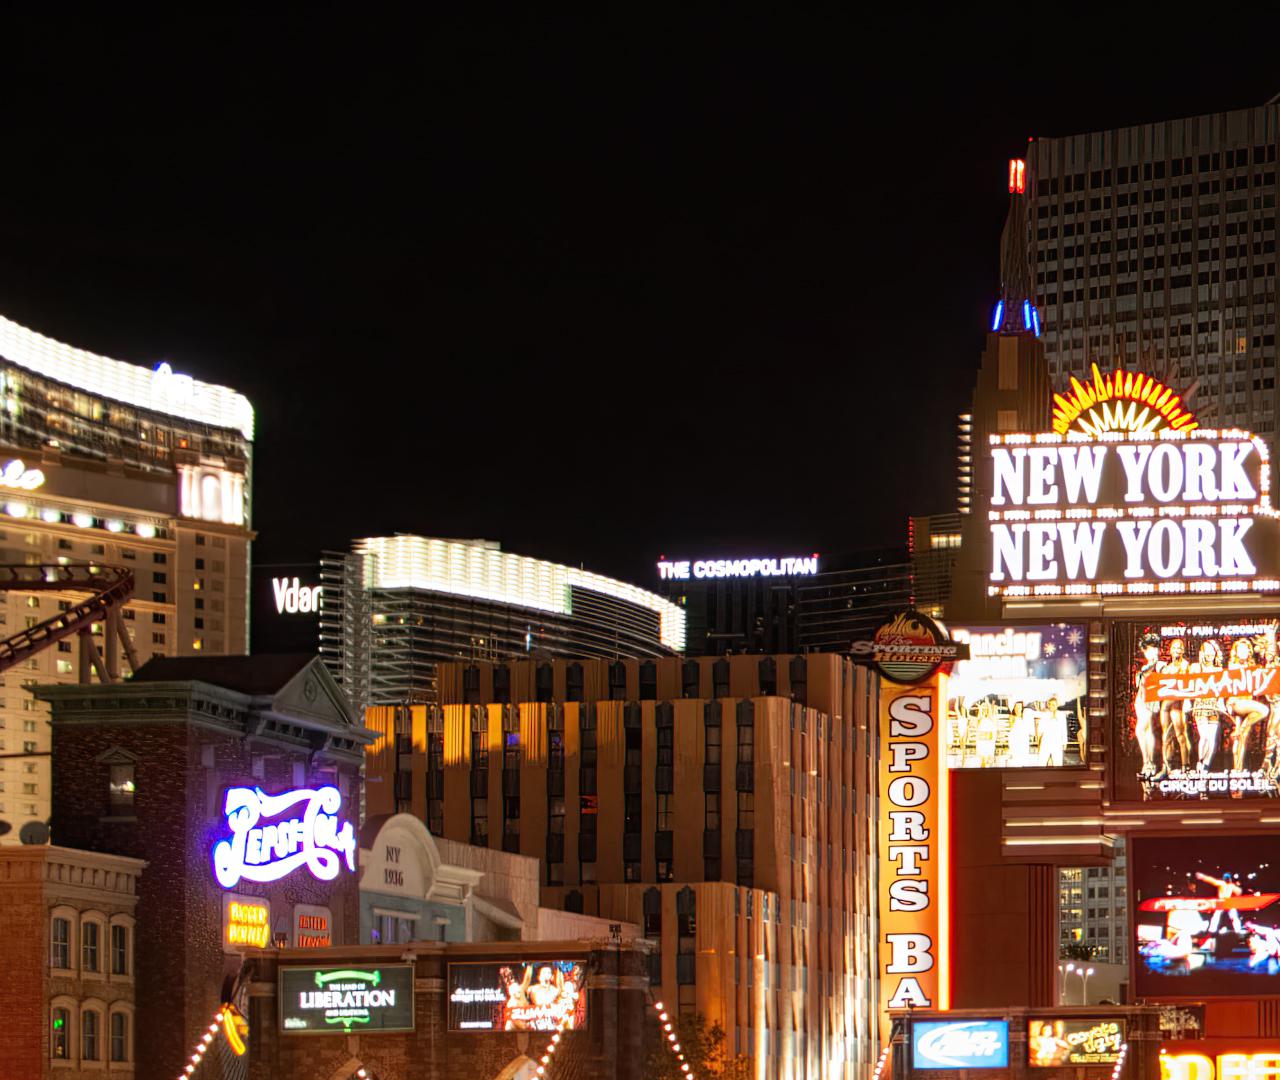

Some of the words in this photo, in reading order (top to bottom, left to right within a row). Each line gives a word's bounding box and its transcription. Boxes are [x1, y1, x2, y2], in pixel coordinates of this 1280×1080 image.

[991, 447, 1105, 506] NEW
[1117, 443, 1256, 503] YORK
[990, 522, 1105, 582] NEW
[1117, 518, 1255, 578] YORK
[658, 560, 691, 579] THE
[696, 558, 818, 578] COSMOPOLITAN
[1191, 626, 1213, 637] FUN
[850, 640, 957, 655] SPORTING
[873, 652, 942, 663] HOUSE
[1157, 668, 1278, 698] ZUMANITY
[1159, 779, 1206, 795] CIRQUE
[1208, 780, 1228, 793] DU
[887, 694, 934, 913] SPORTS
[386, 846, 402, 864] NY
[886, 933, 935, 1008] BA
[300, 989, 395, 1009] LIBERATION
